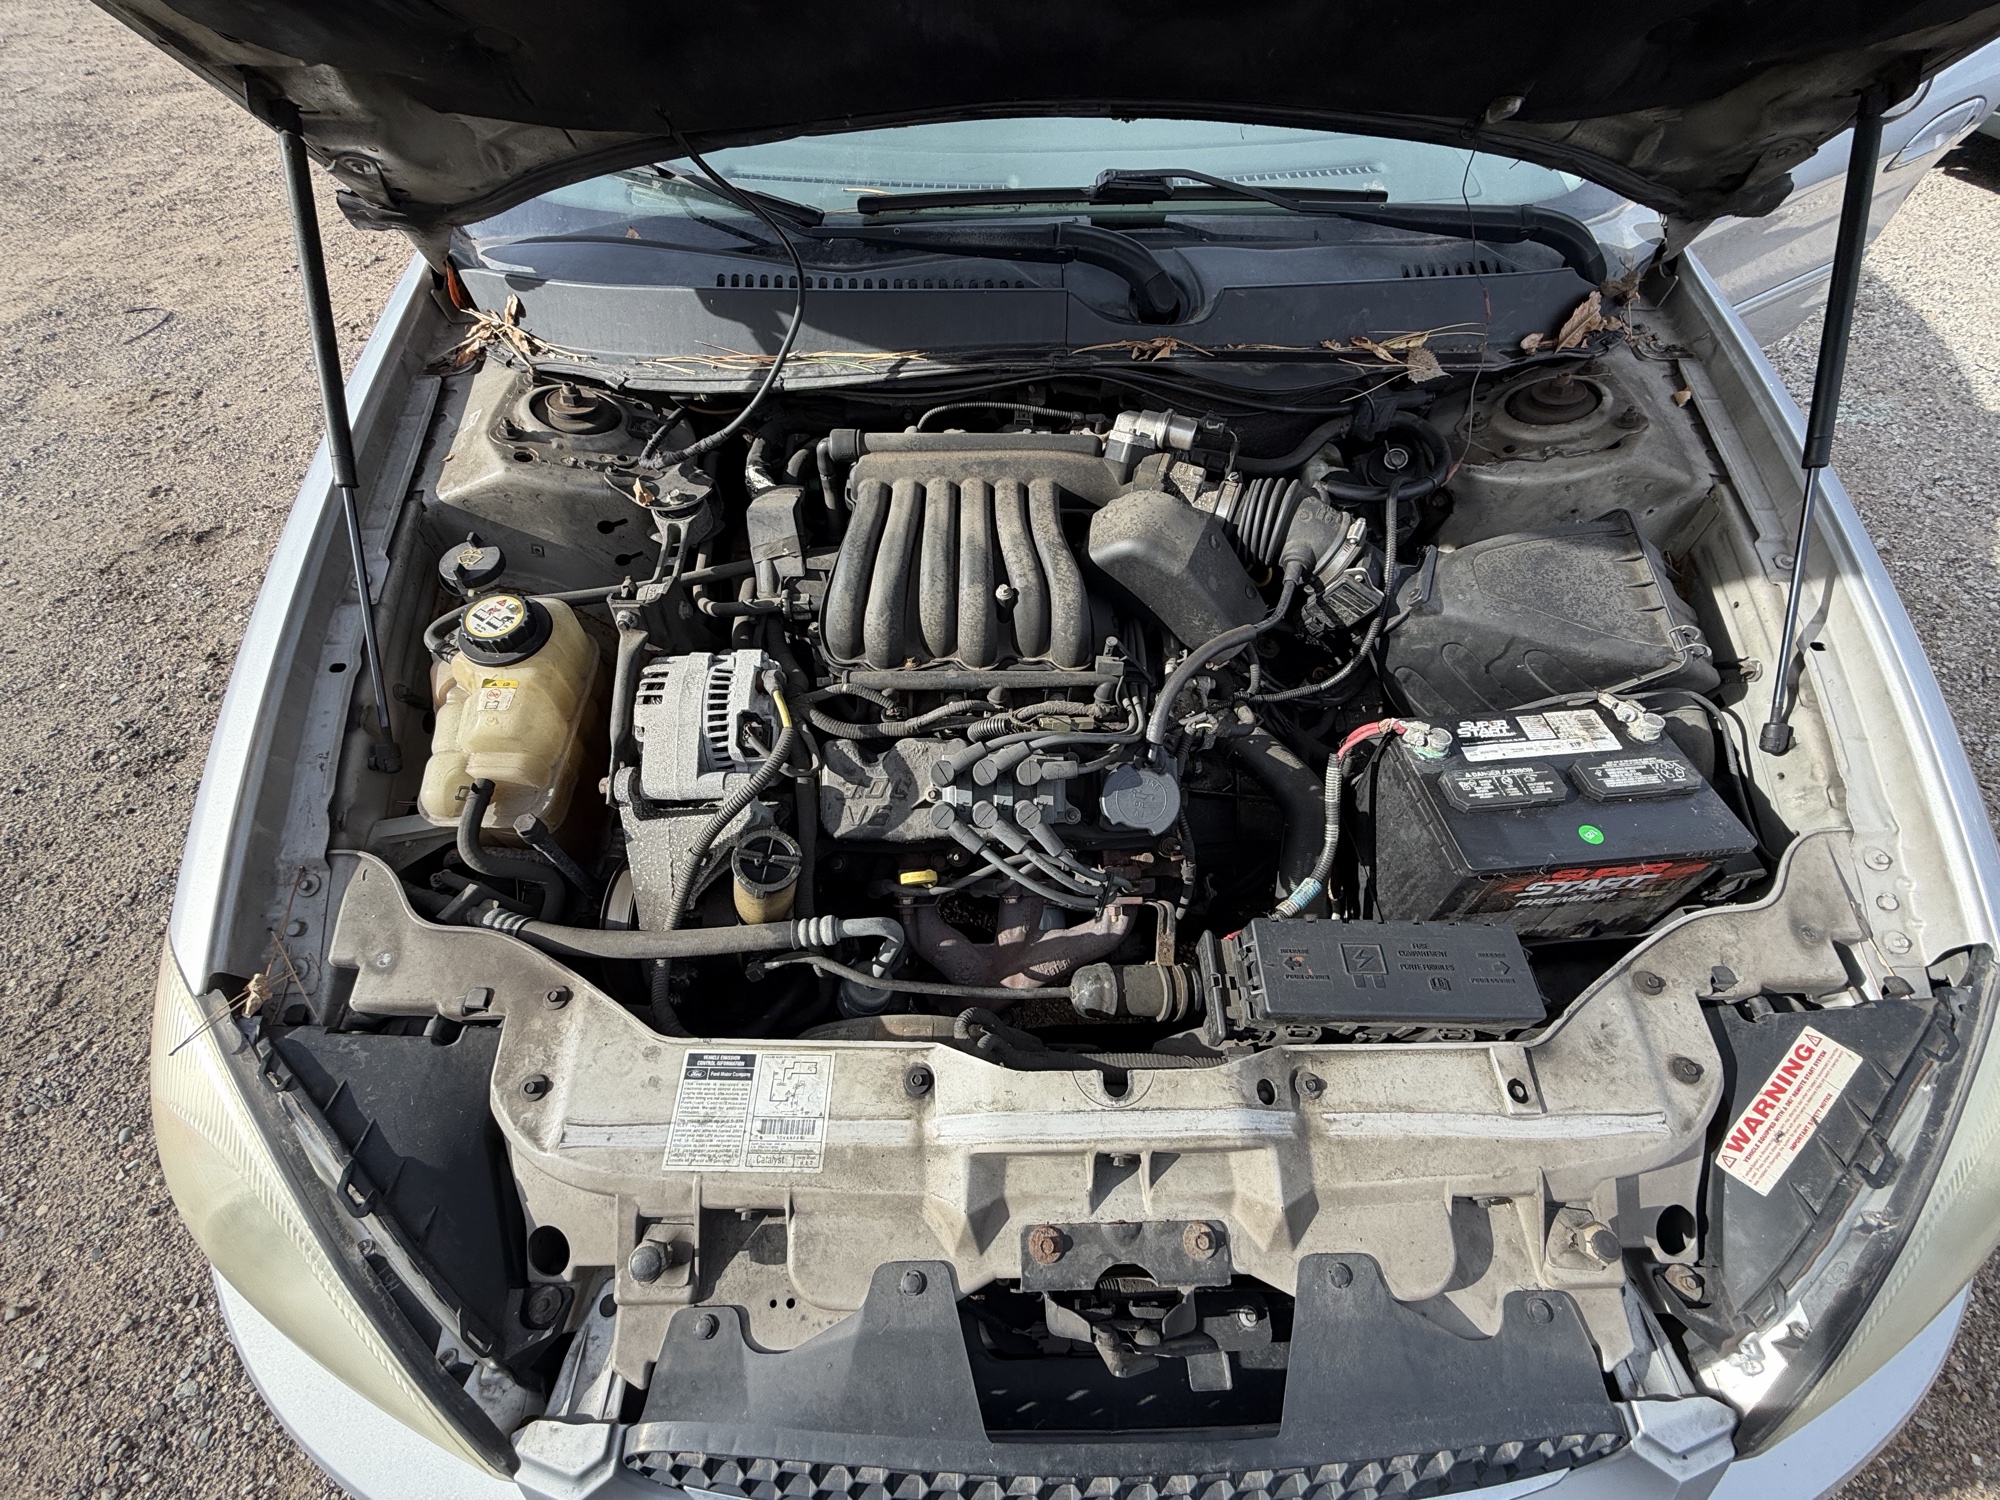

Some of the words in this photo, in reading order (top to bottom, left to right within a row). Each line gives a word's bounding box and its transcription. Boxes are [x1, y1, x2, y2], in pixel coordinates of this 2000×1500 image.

[1457, 728, 1508, 738] START
[1459, 720, 1510, 729] SUPER
[1506, 767, 1534, 775] POISON
[1134, 800, 1147, 809] OIL
[847, 804, 893, 827] V6
[1548, 862, 1673, 882] SUPER
[1515, 874, 1661, 897] START
[1515, 892, 1618, 907] PREMIUM
[1726, 1044, 1815, 1153] WARNING
[1743, 1142, 1760, 1163] VEHICLE
[1757, 1120, 1776, 1144] EQUIPPED
[1773, 1109, 1785, 1122] WITH
[1791, 1079, 1806, 1097] REMOTE
[1803, 1065, 1816, 1080] START
[1812, 1049, 1826, 1066] SYSTEM
[1789, 1124, 1810, 1151] IMPORTANT
[1807, 1108, 1822, 1125] SAETY
[1818, 1092, 1832, 1109] NOTICE
[756, 1154, 785, 1165] Catalyst
